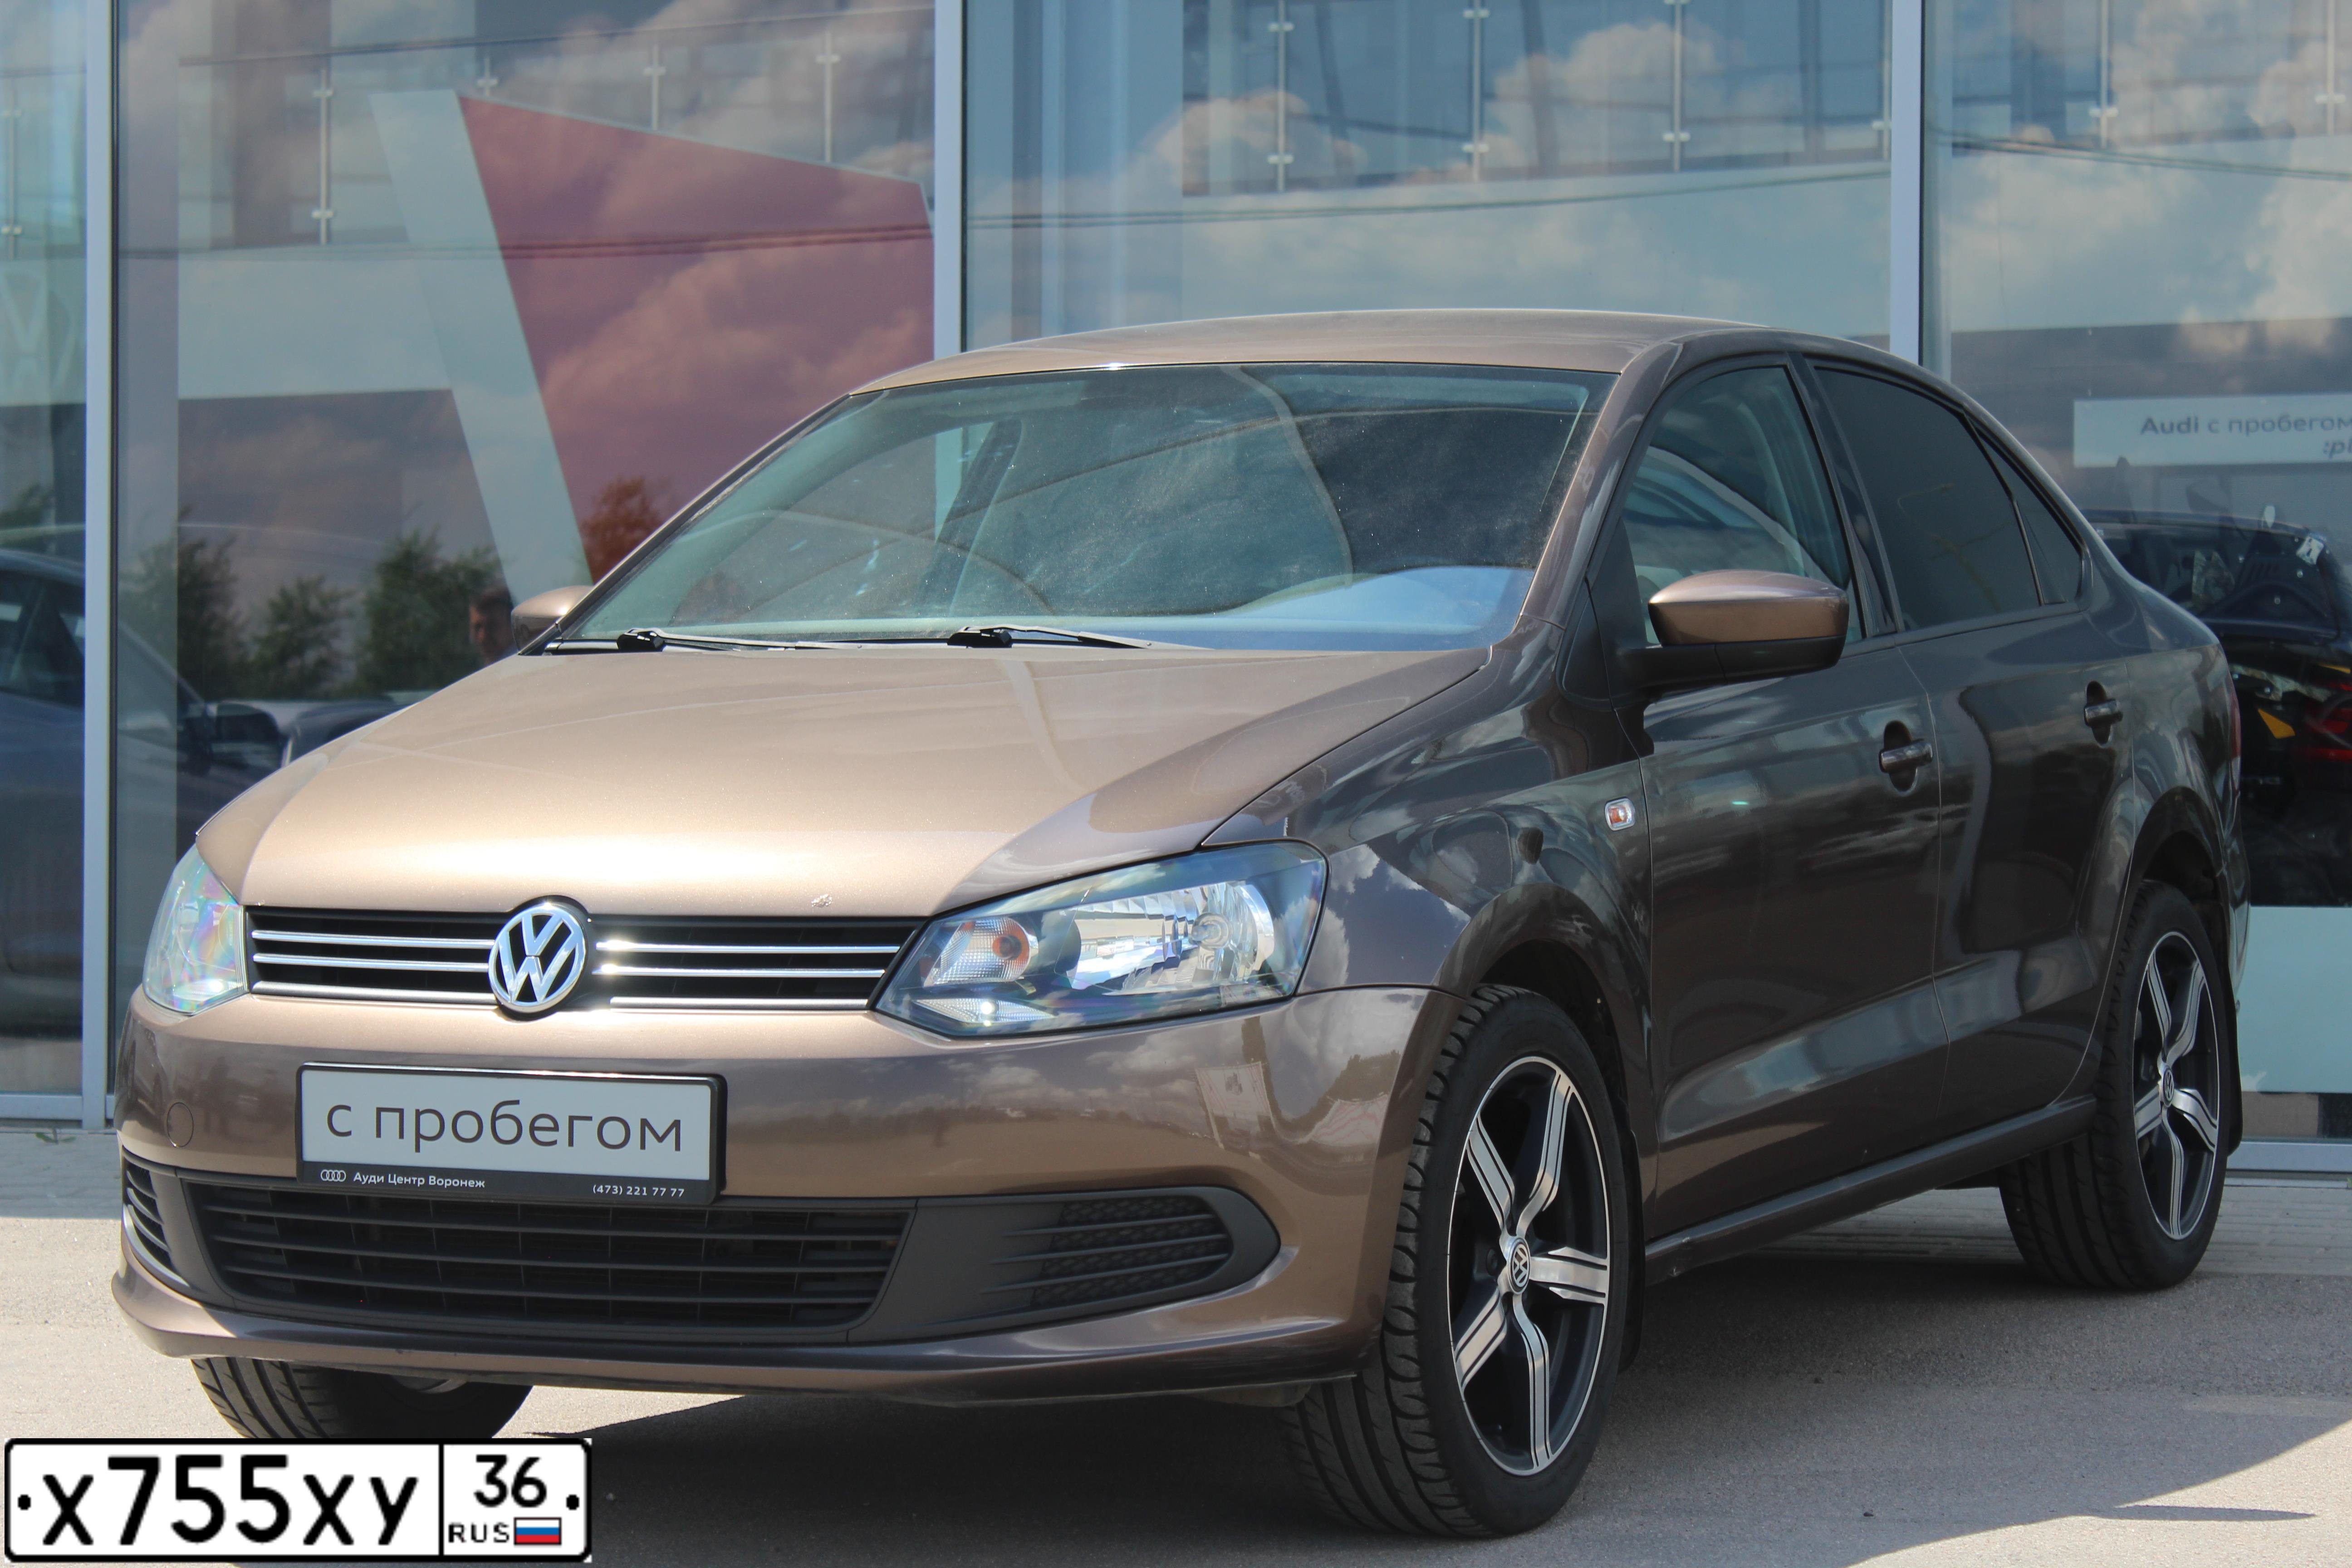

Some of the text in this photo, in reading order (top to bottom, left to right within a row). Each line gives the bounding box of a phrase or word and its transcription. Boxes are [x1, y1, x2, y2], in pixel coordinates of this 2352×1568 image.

[2140, 416, 2200, 435] Audi
[327, 1099, 681, 1153] с пробегом
[353, 1171, 485, 1188] Ауди Центр Воронеж
[592, 1184, 685, 1197] (473) 221 77 77
